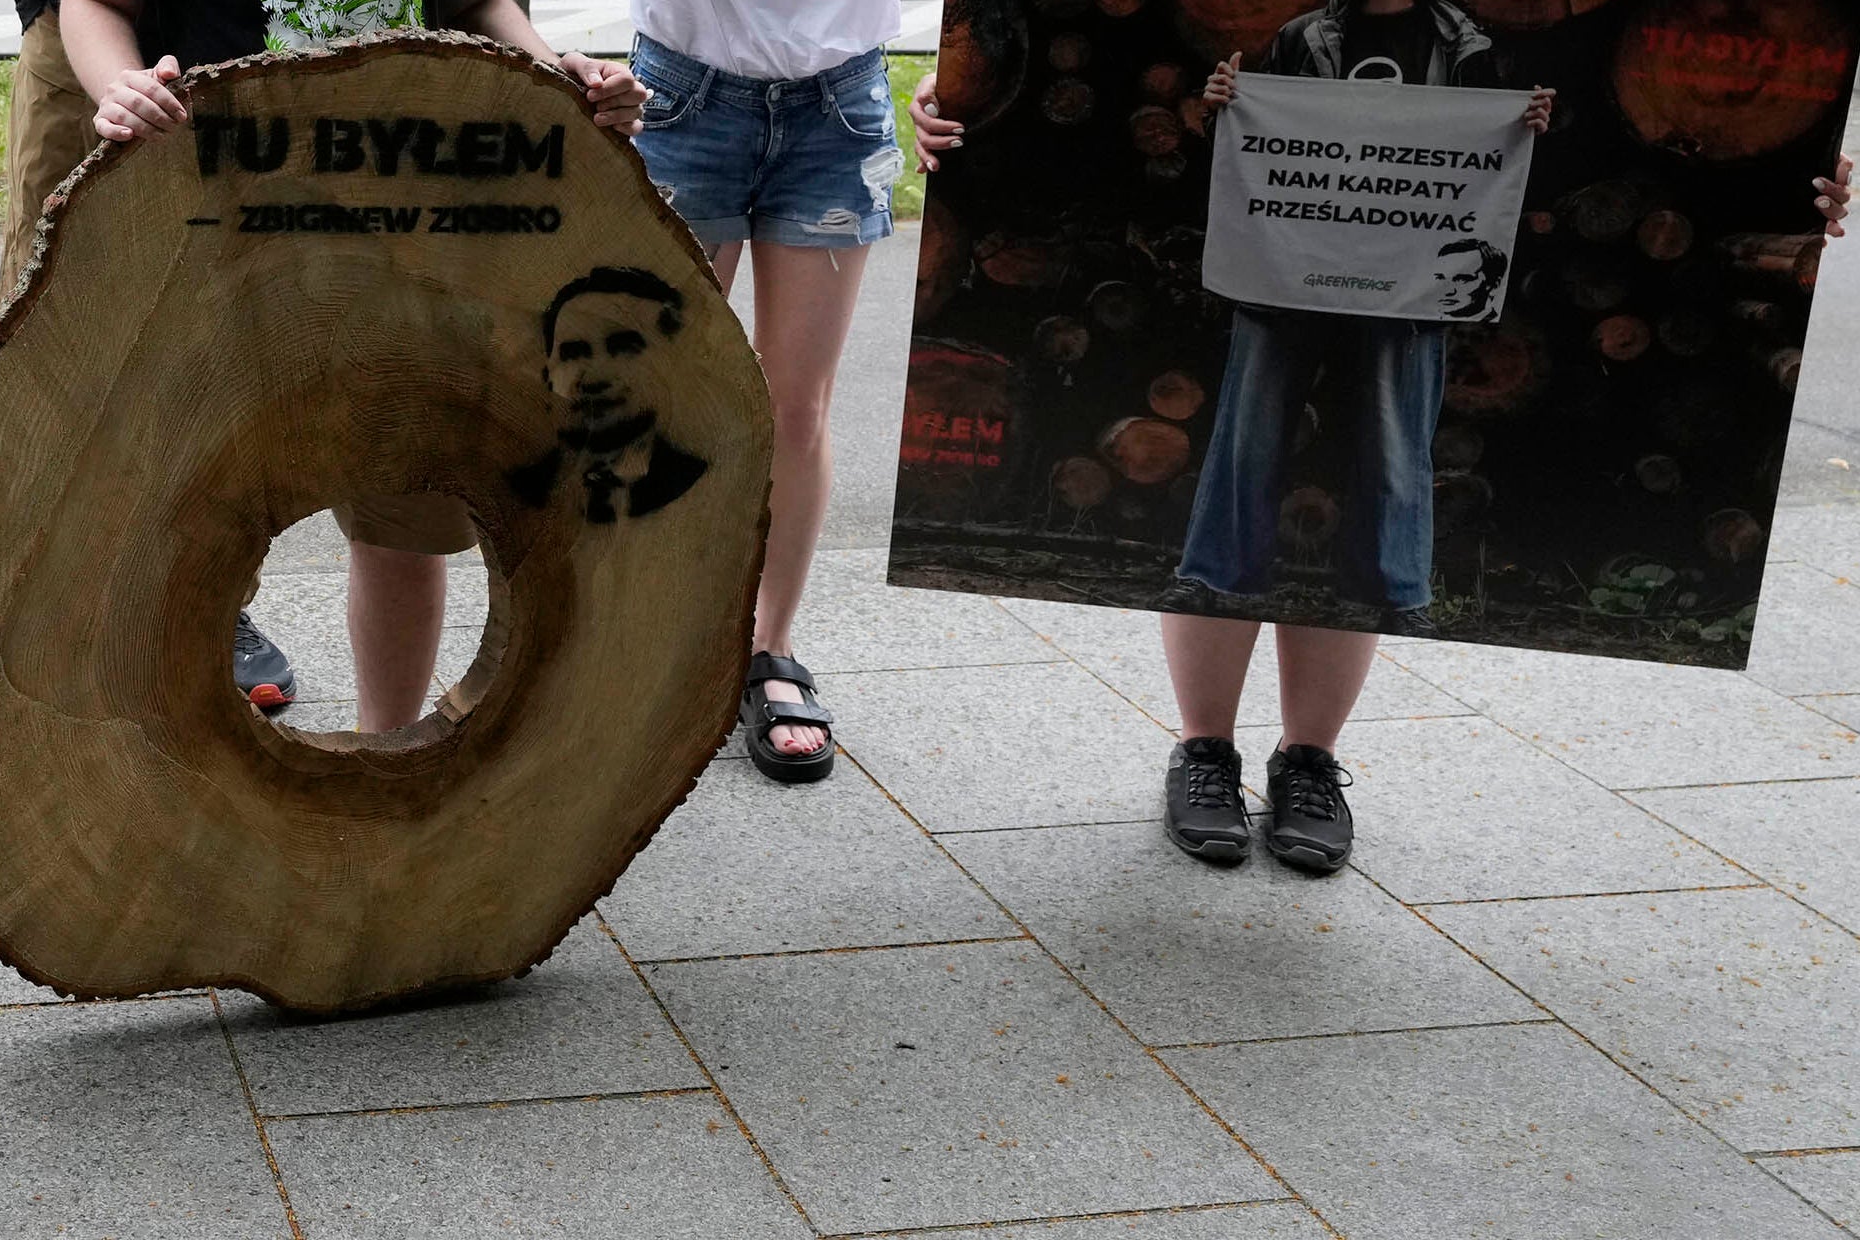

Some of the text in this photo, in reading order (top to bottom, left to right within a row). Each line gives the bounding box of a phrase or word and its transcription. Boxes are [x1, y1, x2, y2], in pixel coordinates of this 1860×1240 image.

[193, 115, 289, 177] TU
[1240, 135, 1503, 171] ZIOBRO, PRZESTAŃ
[1267, 169, 1467, 200] NAM KARPATY
[428, 205, 563, 233] ZIOBRO
[1247, 199, 1477, 233] PRZEŚLADOWAĆ
[1303, 274, 1396, 292] GREENPEACE
